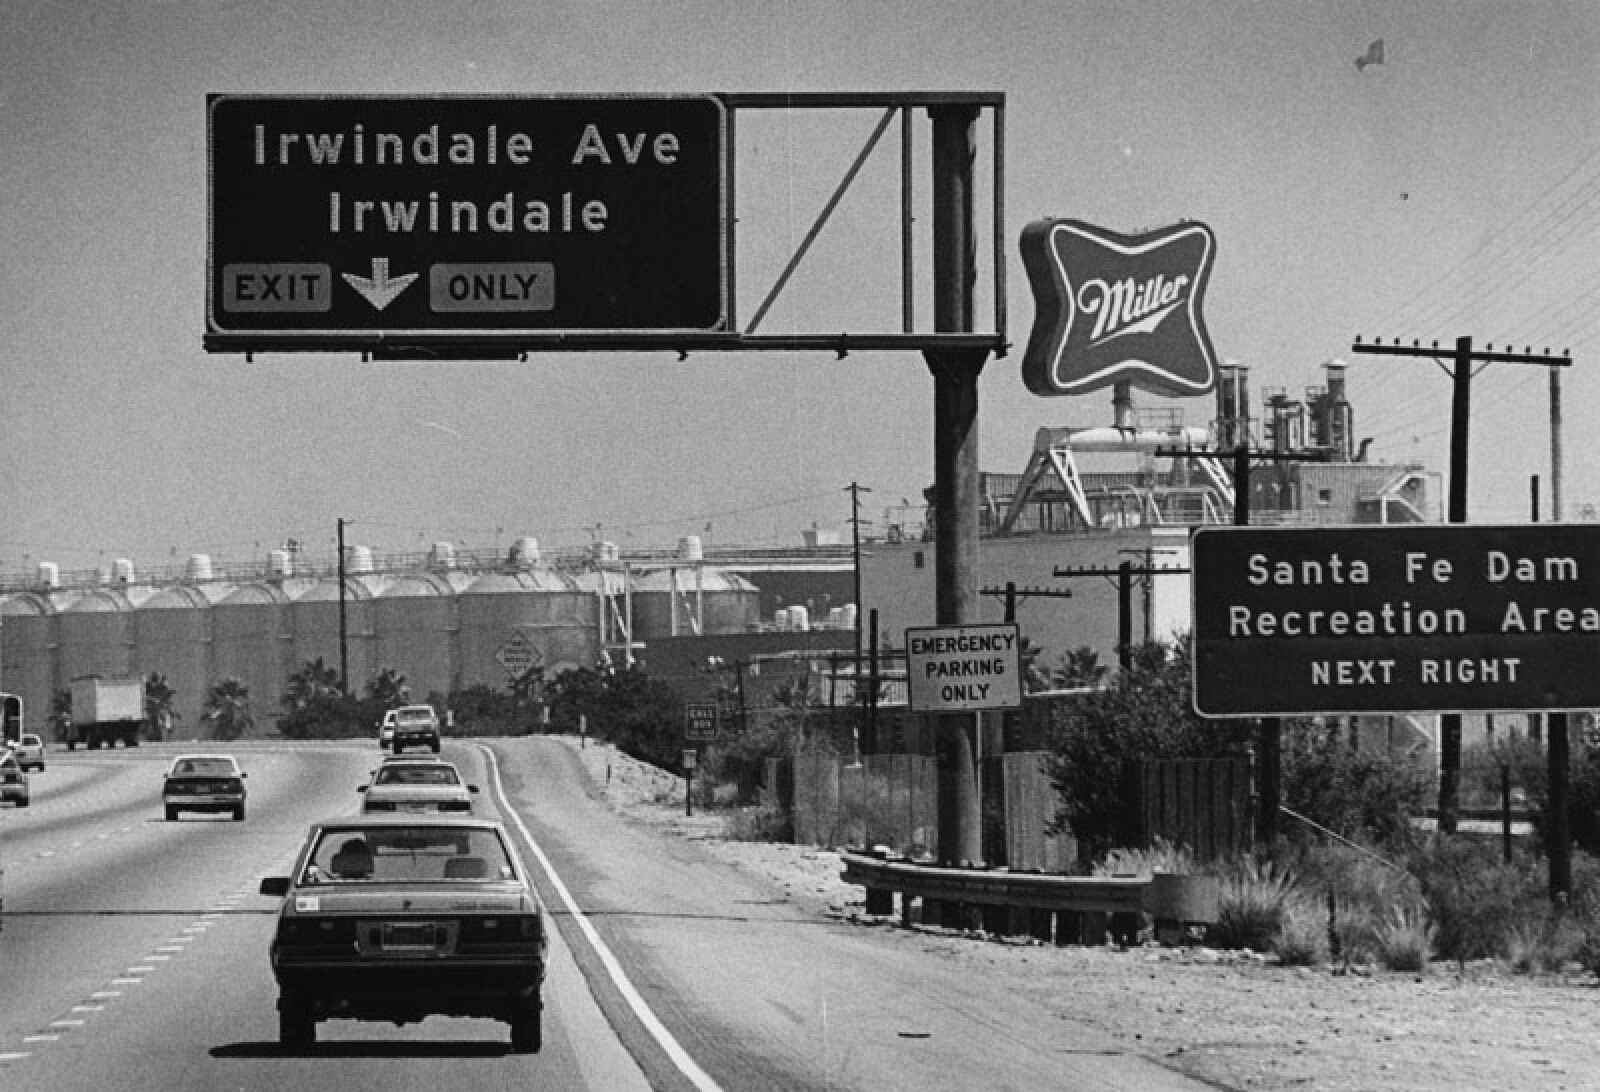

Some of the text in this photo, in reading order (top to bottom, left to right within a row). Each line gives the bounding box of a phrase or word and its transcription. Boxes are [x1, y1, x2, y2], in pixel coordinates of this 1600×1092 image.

[255, 124, 680, 164] Irwindale Ave
[330, 192, 608, 232] Irwindale
[236, 273, 538, 301] EXIT ONLY
[1078, 274, 1188, 340] Miller
[1248, 551, 1578, 585] Santa Fe Dam
[1229, 602, 1600, 637] Recreation Area
[912, 634, 1014, 654] EMERGENCY
[926, 658, 1004, 678] PARKING
[1312, 658, 1520, 685] NEXT RIGHT
[942, 684, 990, 702] ONLY
